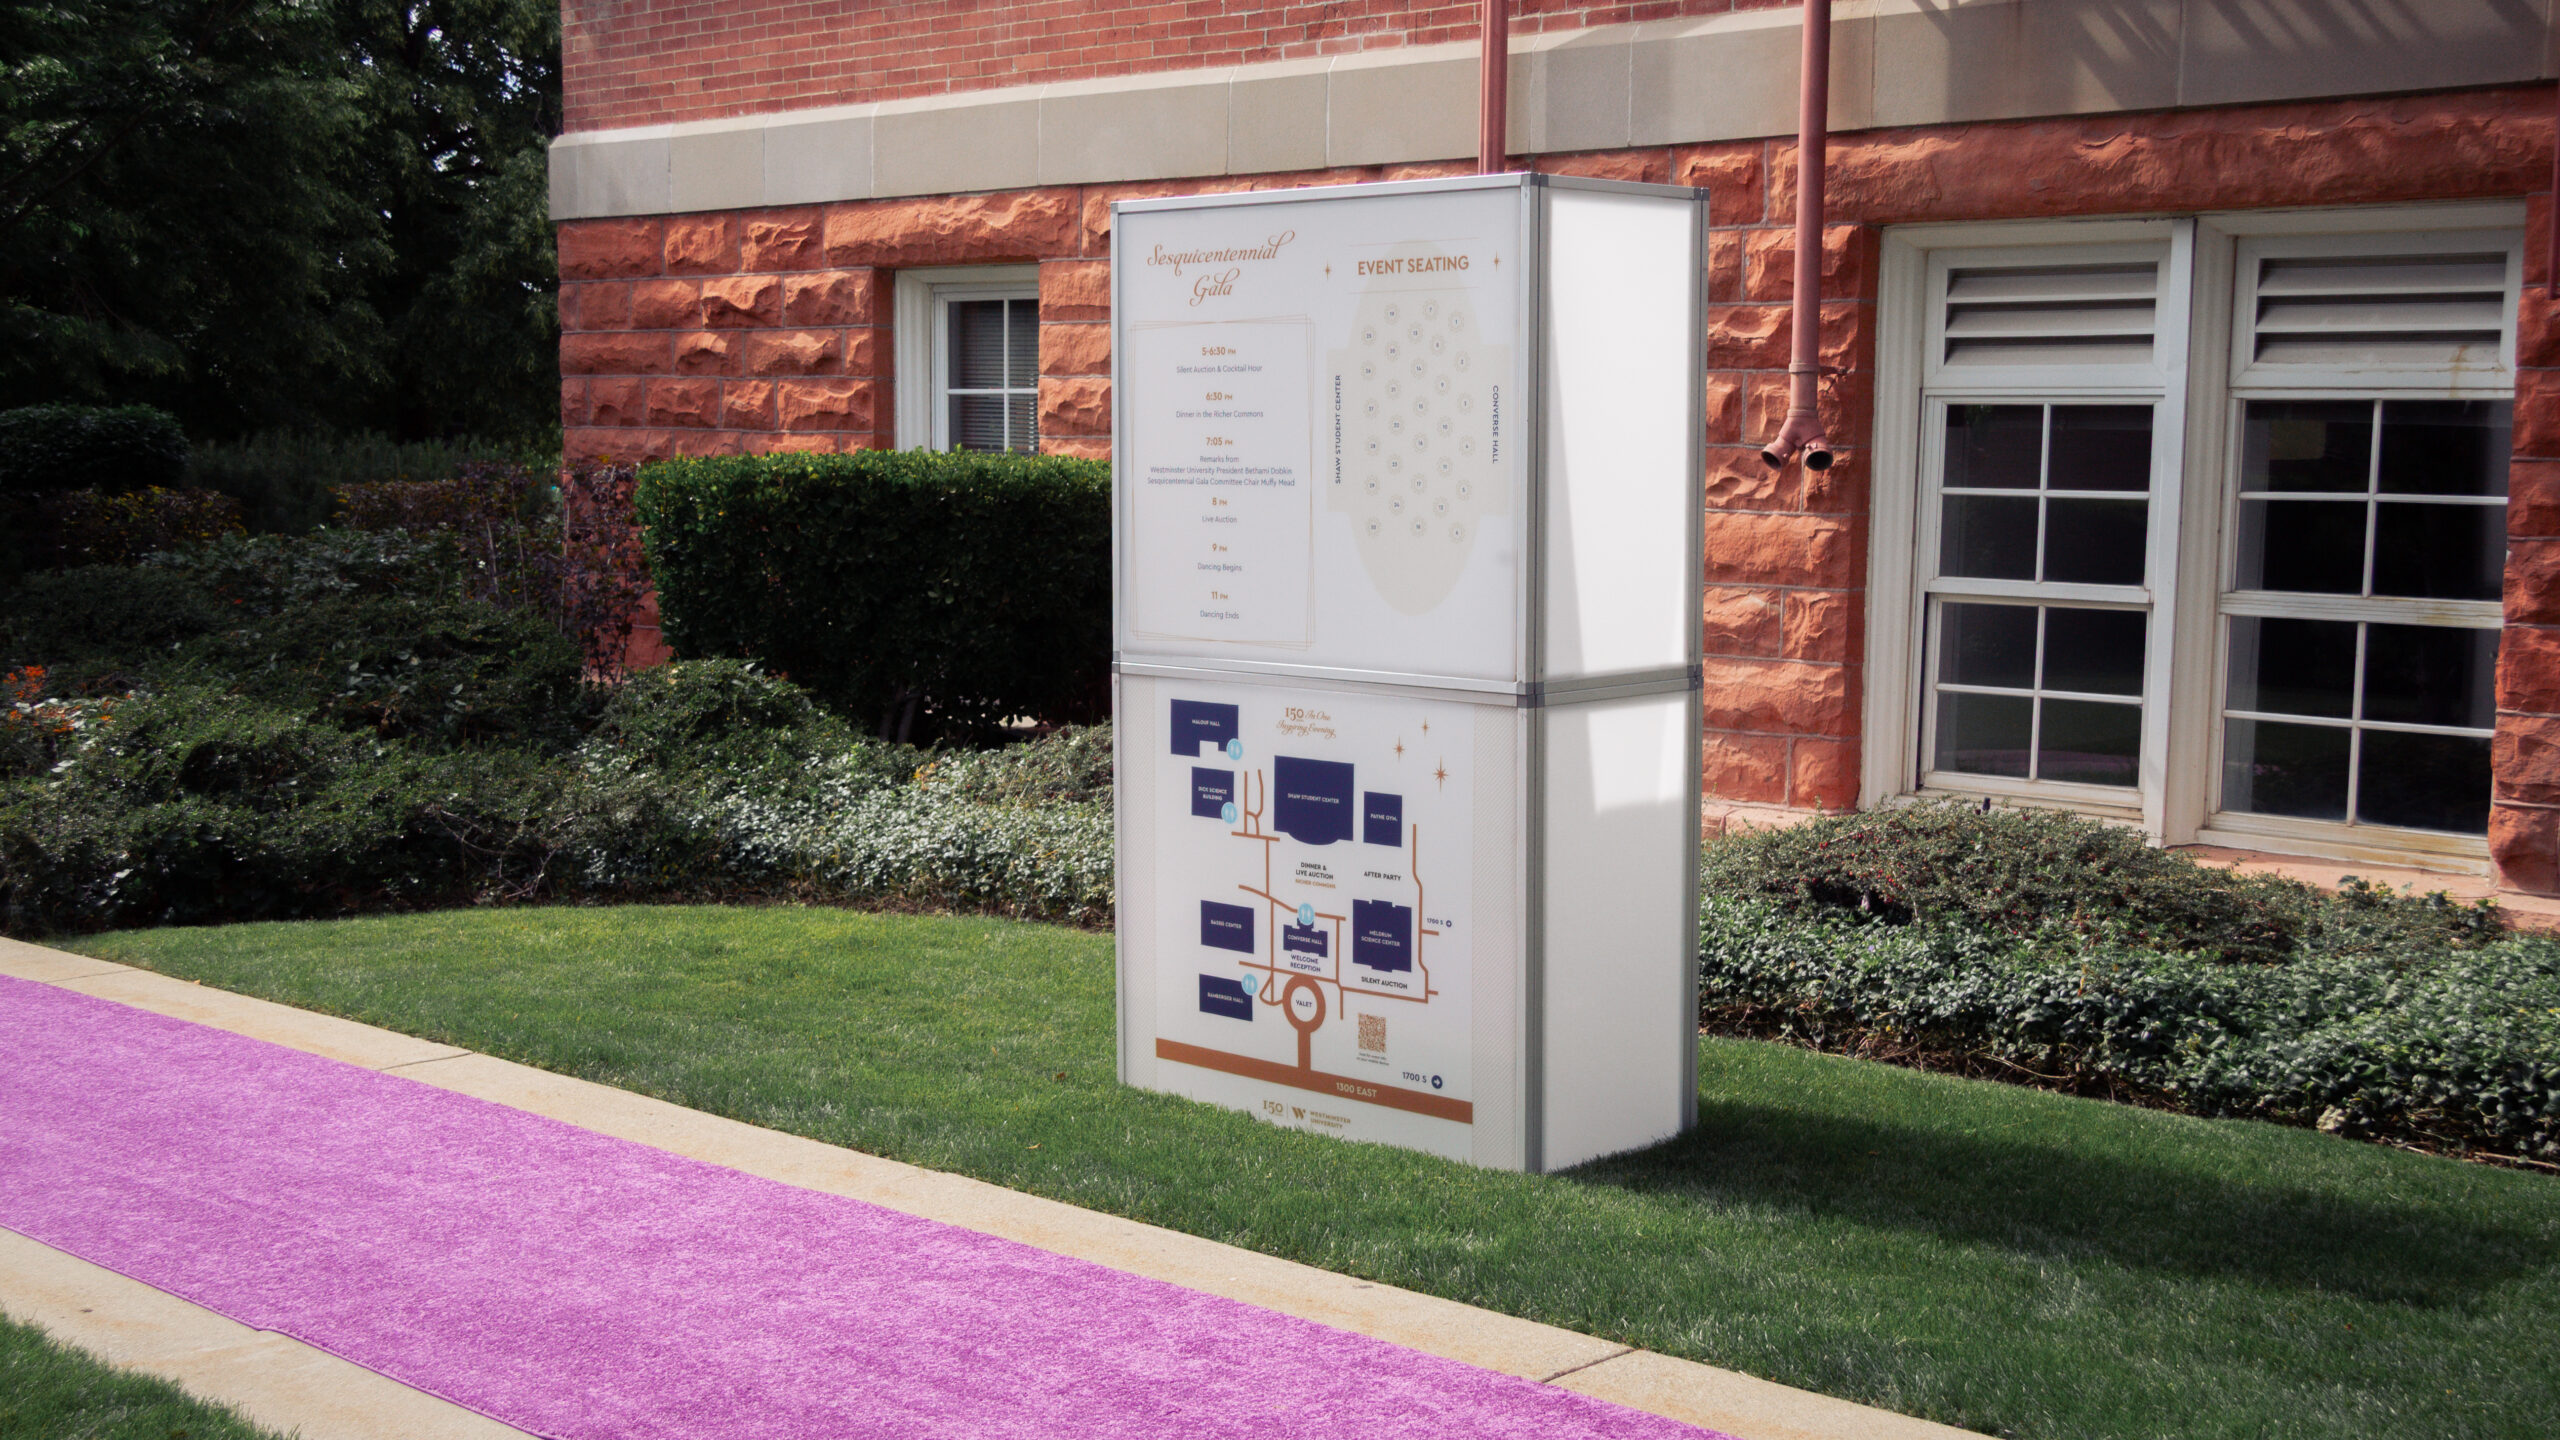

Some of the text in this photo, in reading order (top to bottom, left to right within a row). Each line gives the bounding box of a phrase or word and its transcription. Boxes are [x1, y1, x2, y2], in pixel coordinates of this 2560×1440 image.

[1147, 230, 1295, 276] Sesquicentennial
[1358, 255, 1469, 276] EVENT SEATING
[1190, 268, 1240, 307] Gala
[1201, 347, 1226, 356] 5-6:30
[1176, 364, 1262, 374] Silent Auction & Cocktail Hour
[1206, 391, 1222, 401] 6:30
[1203, 410, 1212, 418] the
[1214, 410, 1232, 418] Richer
[1234, 410, 1264, 418] Commons
[1206, 437, 1222, 446] 7:05
[1225, 455, 1239, 463] from
[1150, 466, 1185, 474] Westminster
[1187, 466, 1214, 476] University
[1216, 466, 1243, 474] President
[1196, 478, 1209, 486] Gala
[1210, 478, 1242, 486] Committee
[1244, 478, 1259, 486] Chair
[1278, 478, 1295, 487] Mead
[1202, 515, 1237, 524] Live Auction
[1212, 543, 1217, 552] 9
[1197, 562, 1242, 573] Dancing Begins
[1211, 592, 1218, 600] 11
[1200, 610, 1224, 619] Dancing
[1285, 707, 1304, 721] 150
[1316, 711, 1331, 721] One
[1308, 723, 1336, 739] Evening
[1301, 794, 1321, 802] STUDENT
[1301, 862, 1320, 871] DINNER
[1296, 869, 1333, 880] LIVE AUCTION
[1364, 871, 1401, 881] AFTER PARTY
[1225, 921, 1242, 929] CENTER
[1287, 934, 1323, 945] CONVERSE HALL
[1361, 936, 1400, 947] SCIENCE CENTER
[1291, 954, 1319, 964] WELCOME
[1290, 962, 1321, 972] RECEPTION
[1361, 976, 1408, 989] SILENT AUCTION
[1233, 995, 1243, 1003] HALL
[1295, 1000, 1312, 1008] VALET
[1402, 1071, 1427, 1083] 1700 S
[1336, 1082, 1377, 1098] 1300 EAST
[1263, 1100, 1284, 1114] 150
[1310, 1111, 1351, 1124] WESTMINSTER
[1311, 1118, 1343, 1129] UNIVERSITY
